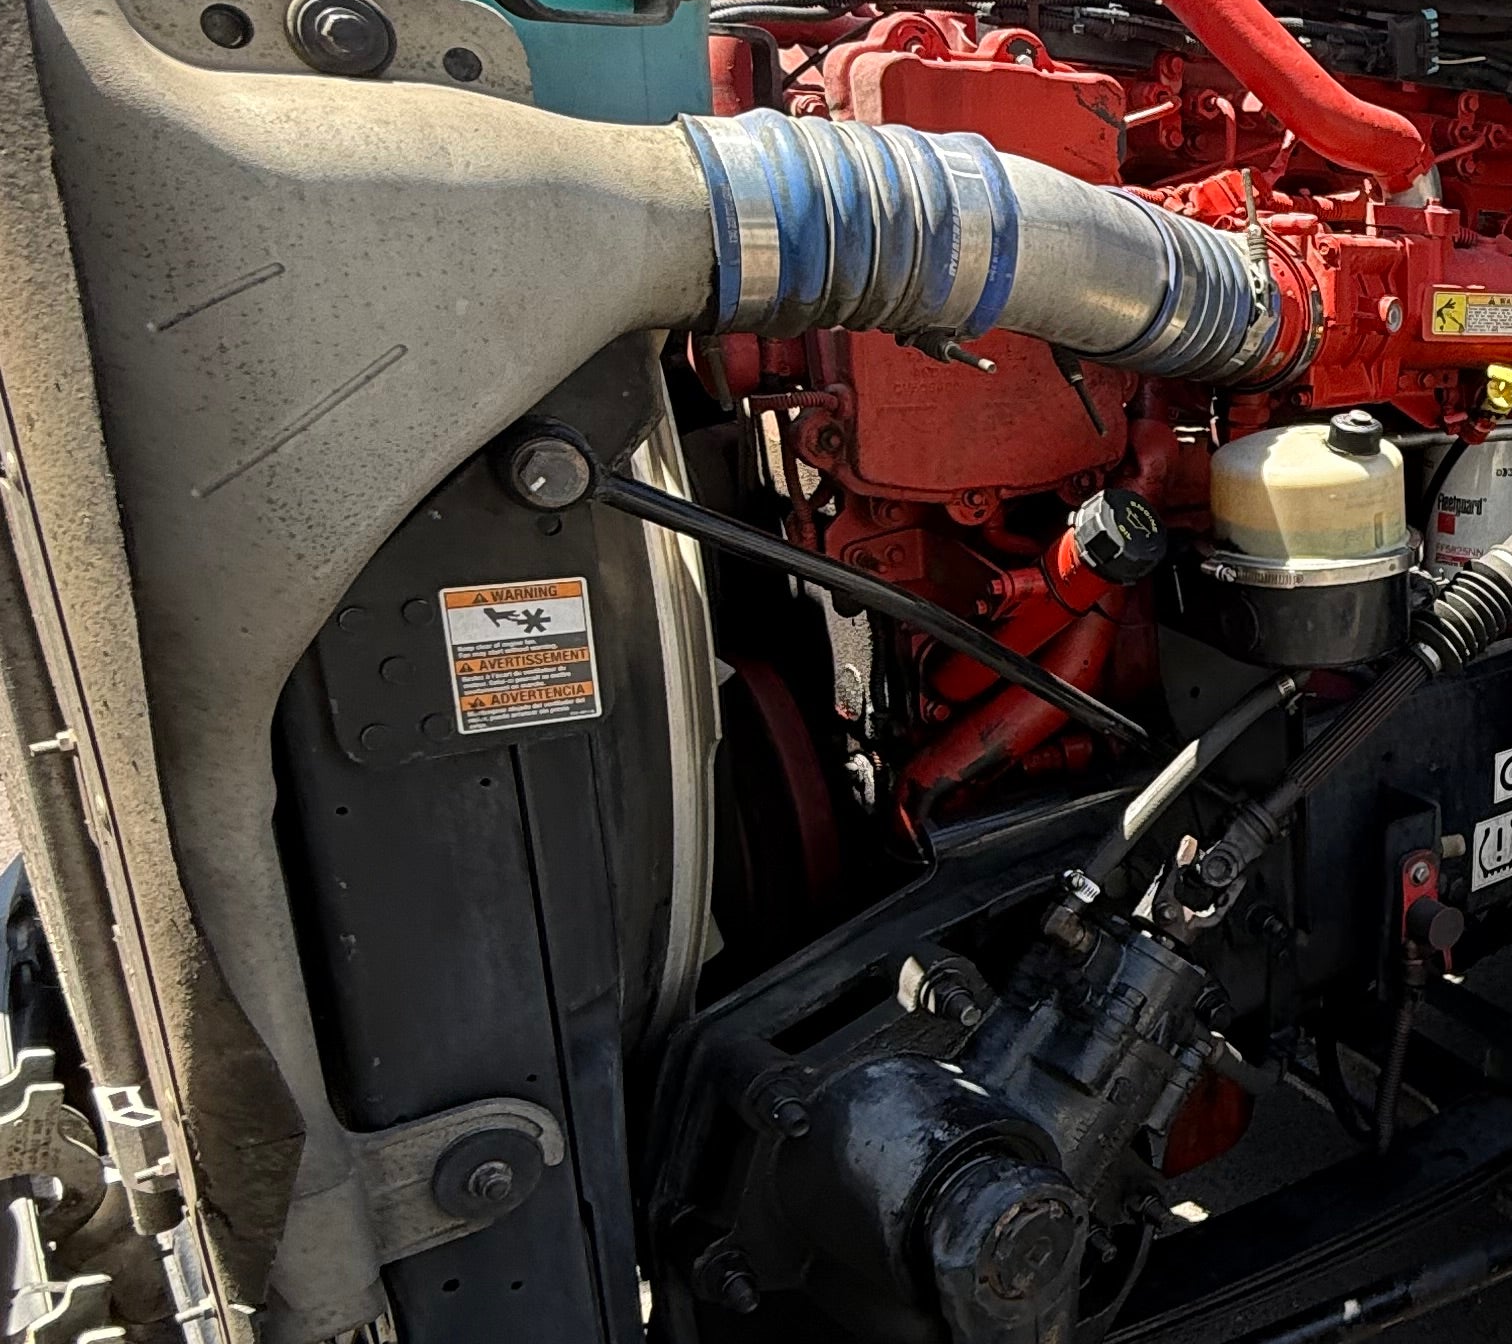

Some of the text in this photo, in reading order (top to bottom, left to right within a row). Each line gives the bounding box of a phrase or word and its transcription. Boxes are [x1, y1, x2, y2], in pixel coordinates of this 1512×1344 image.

[490, 585, 557, 602] WARNING
[479, 648, 587, 671] AVERTISSEMENT
[490, 684, 586, 705] ADVERTENCIA
